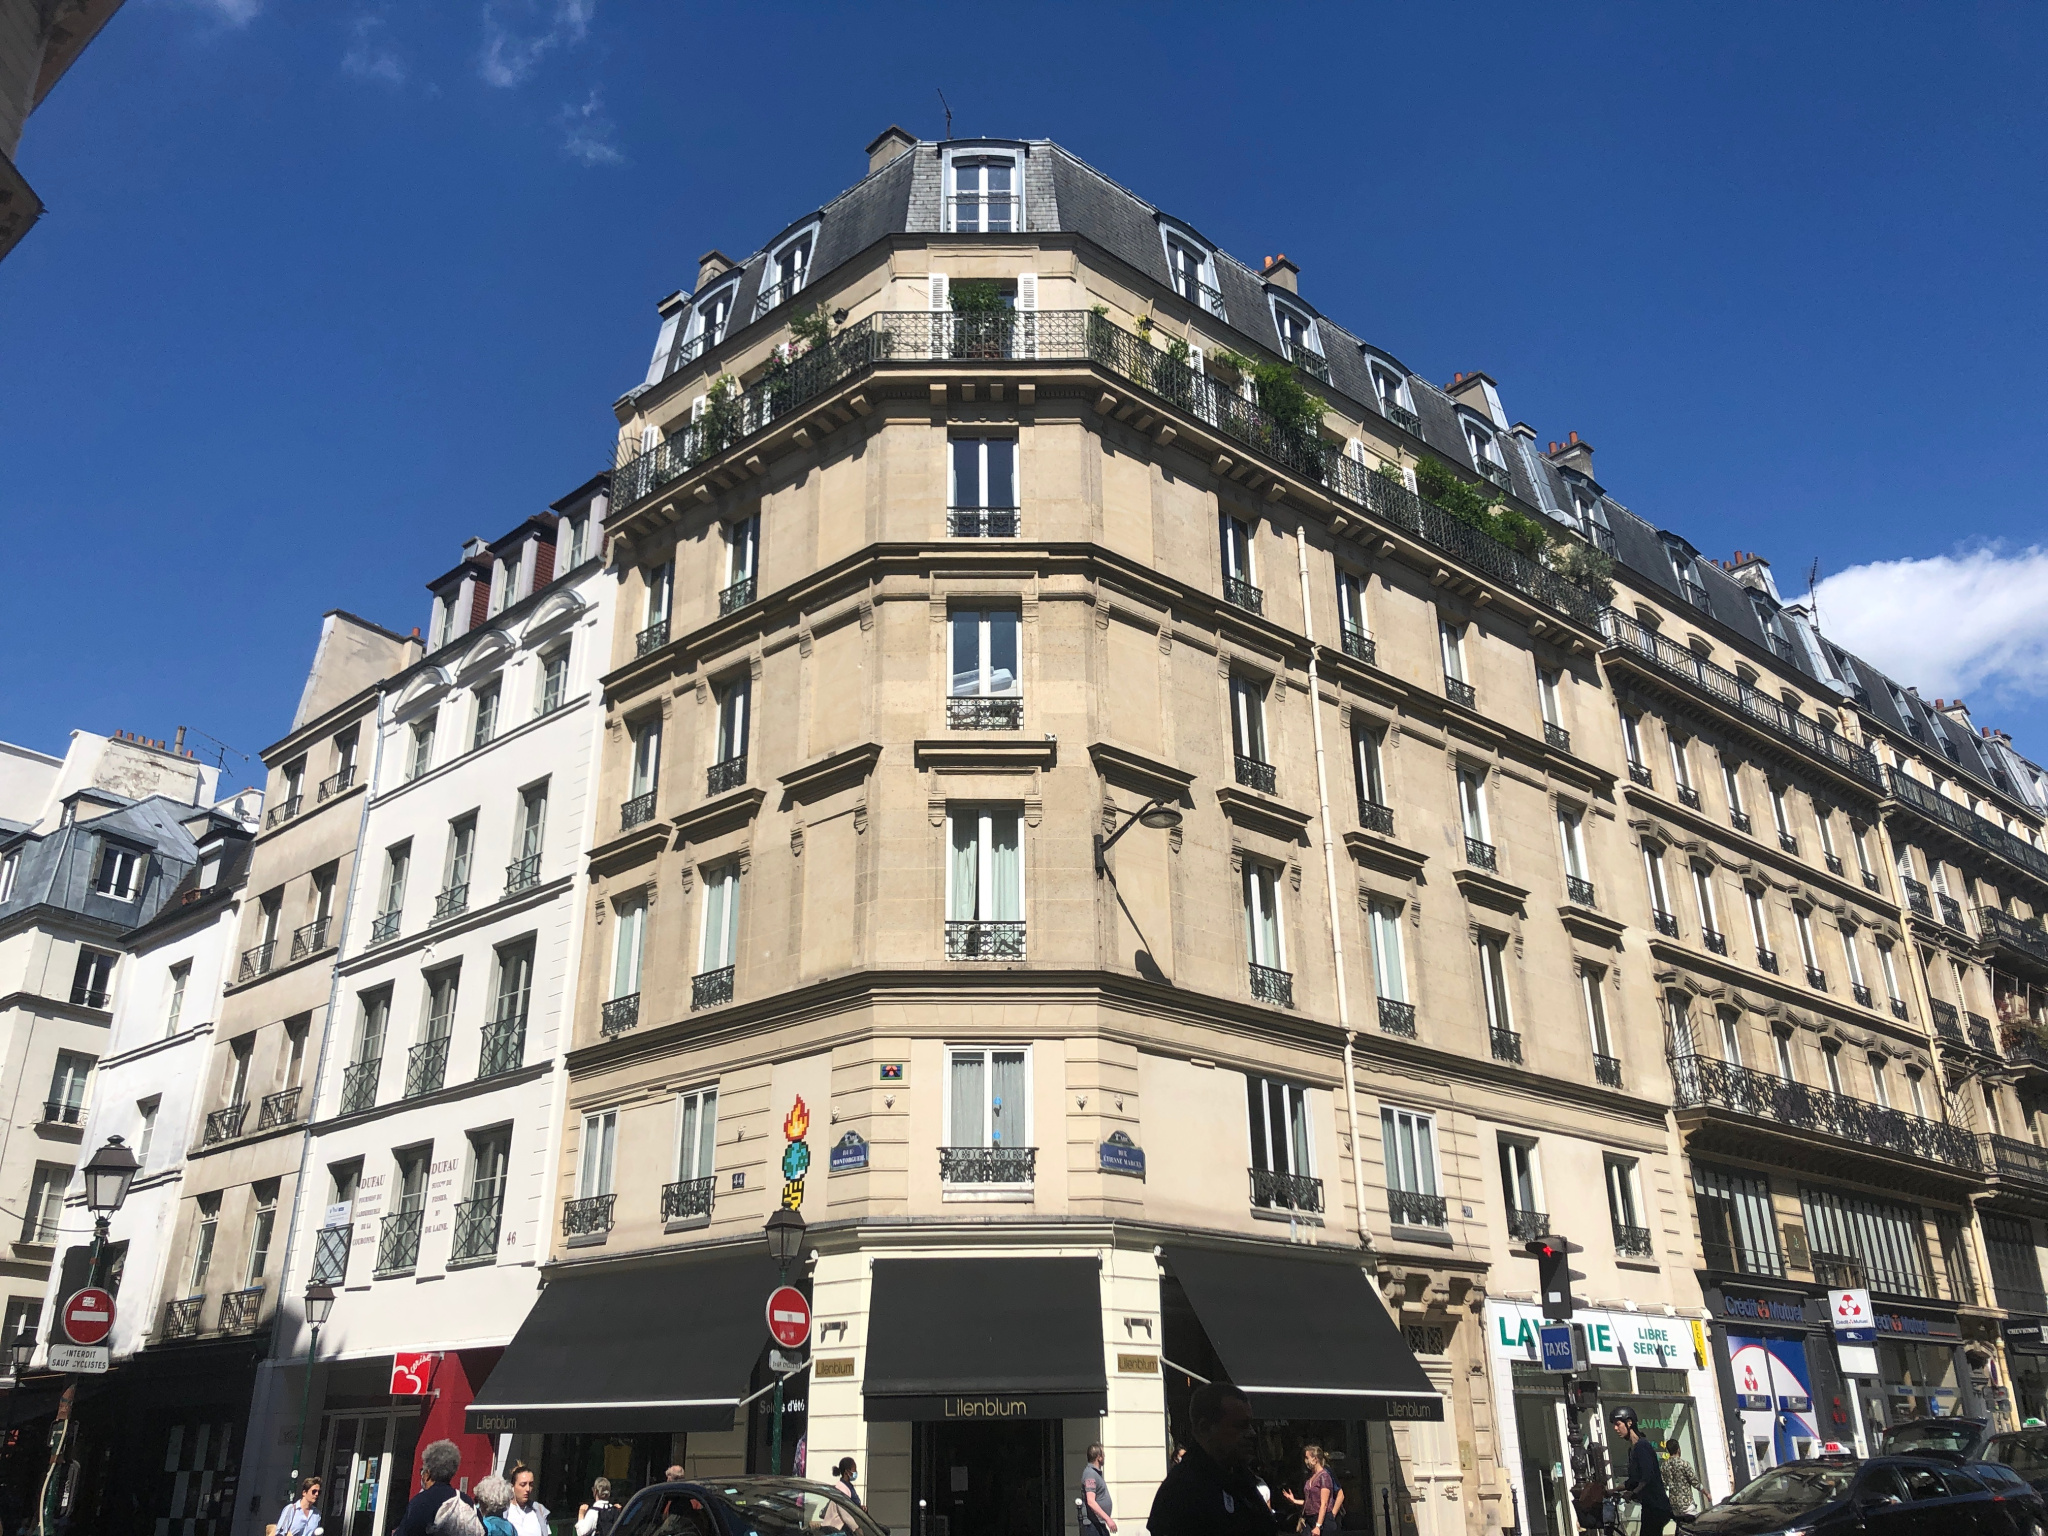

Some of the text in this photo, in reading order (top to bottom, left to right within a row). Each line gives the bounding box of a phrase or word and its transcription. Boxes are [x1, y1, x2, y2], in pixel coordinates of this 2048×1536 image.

[1118, 1149, 1128, 1158] RUE
[431, 1158, 459, 1174] DUFAU
[1123, 1159, 1143, 1168] MARCEL
[361, 1174, 386, 1189] DUFAU
[733, 1173, 744, 1186] 44
[424, 1225, 431, 1234] DE
[506, 1231, 517, 1246] 46
[1768, 1301, 1803, 1321] Mutuel
[1901, 1316, 1929, 1334] Mutuel
[1638, 1327, 1668, 1342] LIBRE
[66, 1349, 97, 1359] INTERDIT
[1544, 1341, 1570, 1357] TAXIS
[1633, 1341, 1678, 1357] SERVICE
[51, 1358, 70, 1367] SAUF
[816, 1361, 855, 1375] Lilenblum
[1118, 1355, 1158, 1371] Lilenblum
[945, 1397, 1027, 1417] Lilenblum
[1385, 1400, 1432, 1418] Lilenblum
[476, 1413, 517, 1430] Lilenblum
